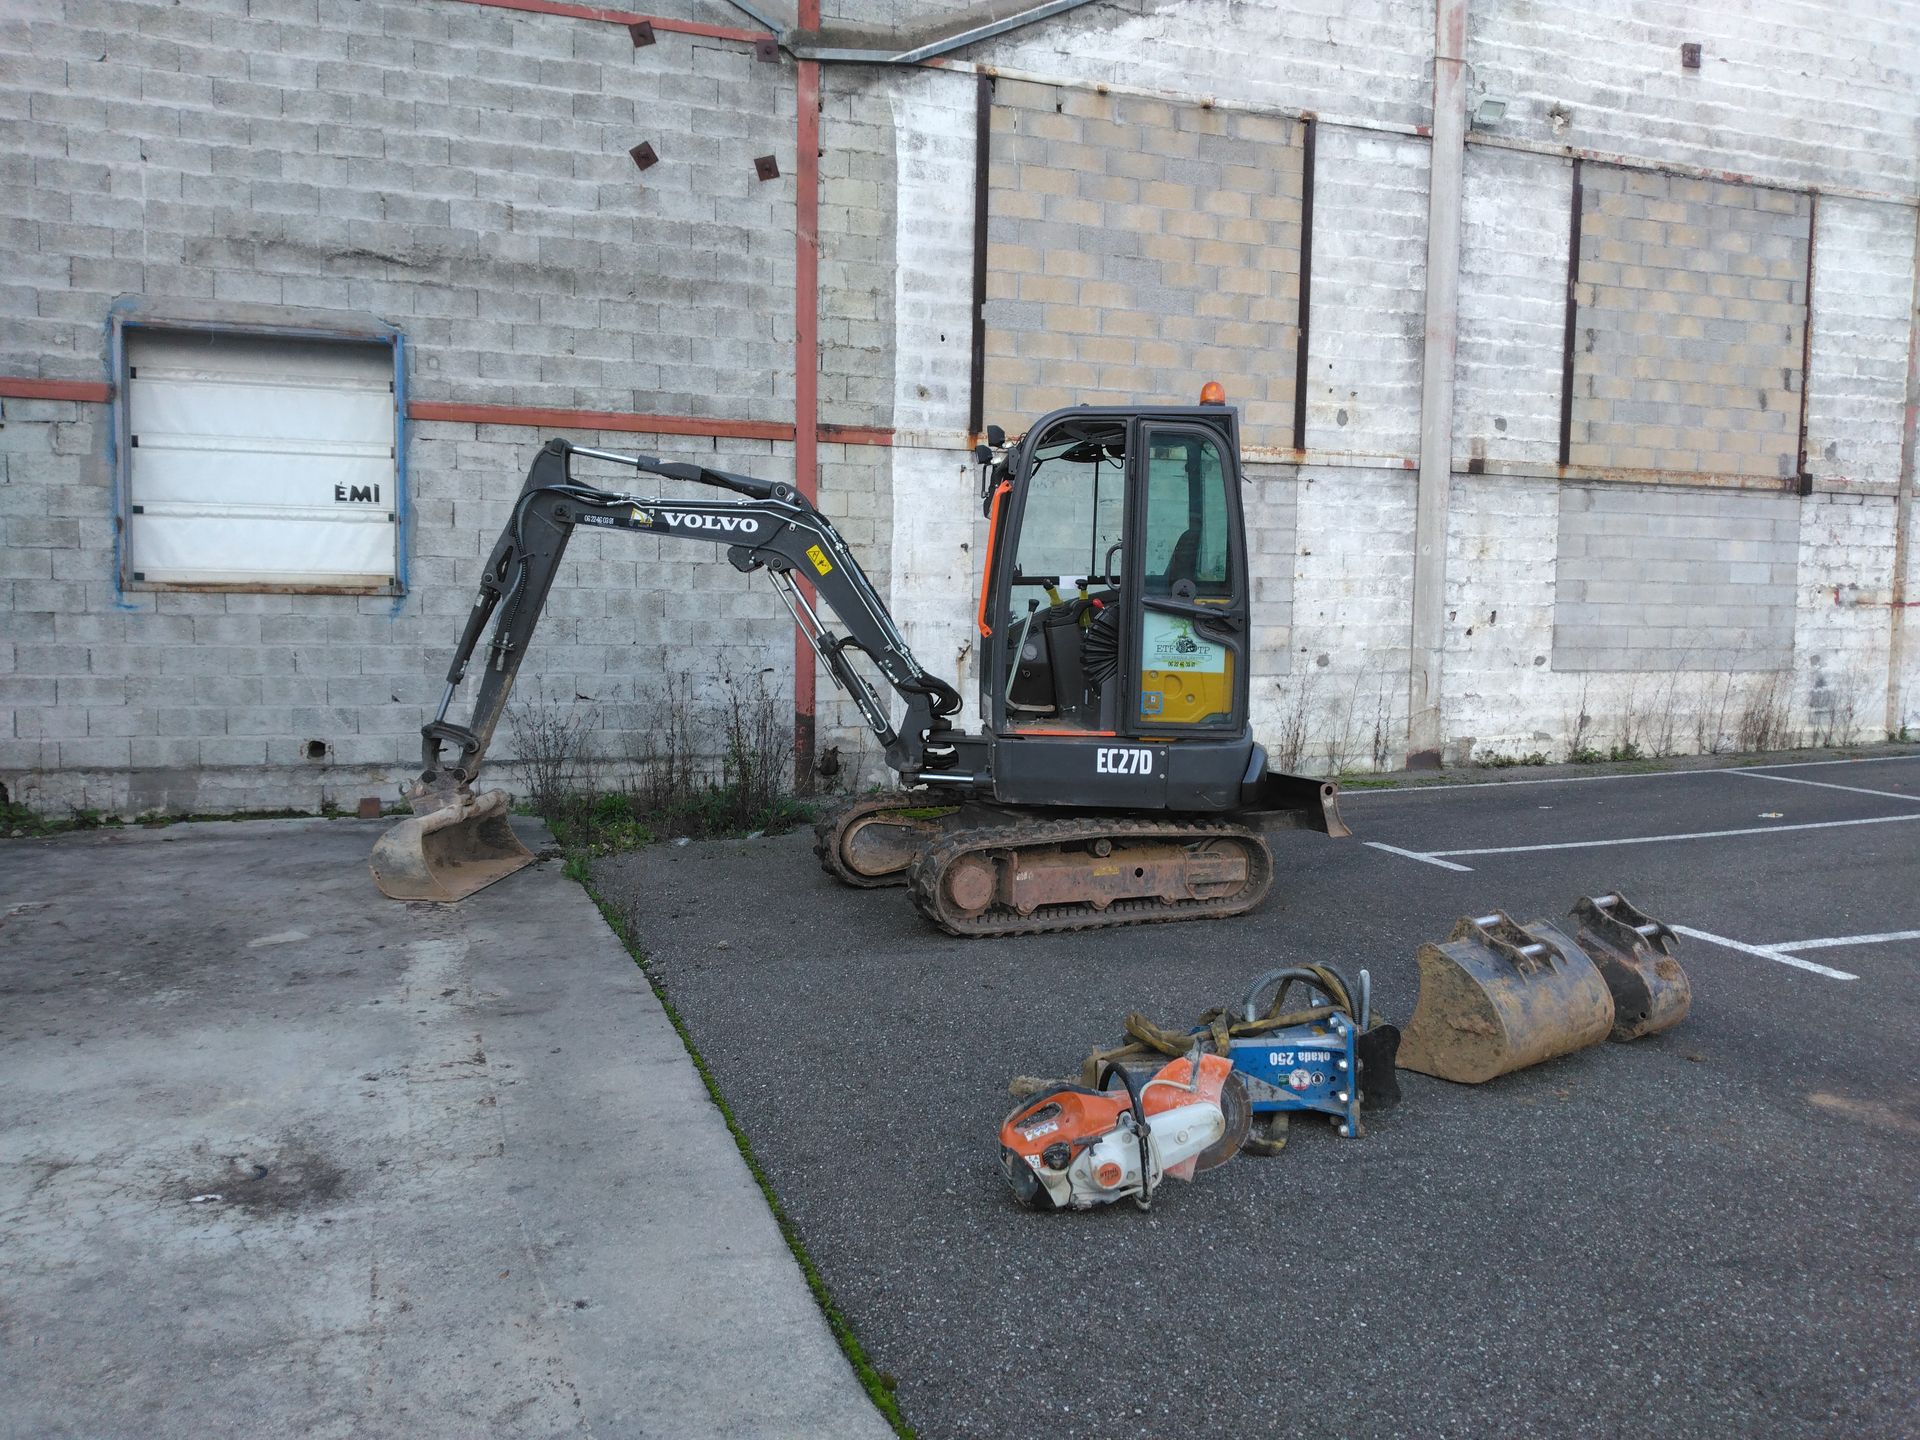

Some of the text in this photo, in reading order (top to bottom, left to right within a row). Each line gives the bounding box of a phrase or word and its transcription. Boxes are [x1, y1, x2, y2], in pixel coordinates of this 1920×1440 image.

[661, 511, 759, 533] VOLVO
[1096, 747, 1153, 775] EC27D
[1269, 1051, 1331, 1066] okada 250
